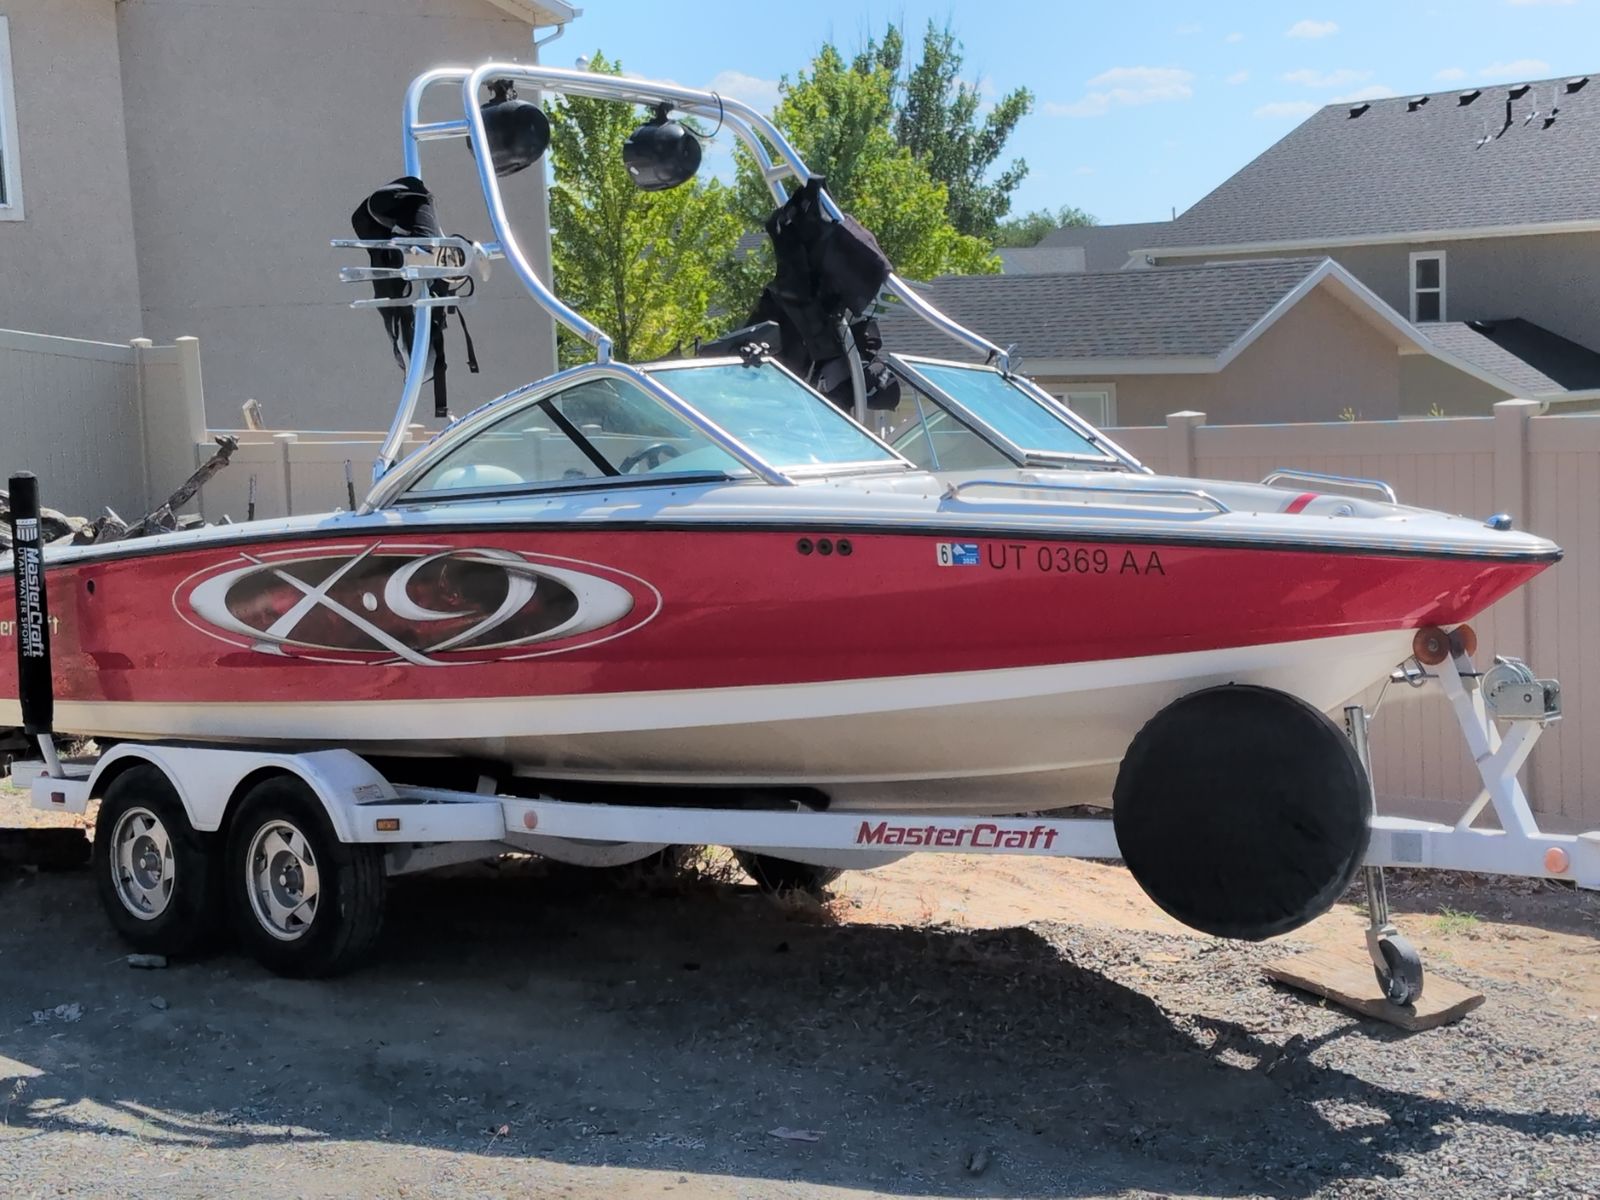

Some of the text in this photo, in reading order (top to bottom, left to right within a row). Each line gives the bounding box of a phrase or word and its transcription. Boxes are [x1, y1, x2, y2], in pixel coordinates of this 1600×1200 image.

[940, 544, 949, 564] 6
[988, 544, 1166, 576] UT 0369 AA
[19, 580, 27, 613] WATER
[26, 547, 45, 658] MasterCraft
[21, 616, 30, 658] SPORTS
[856, 821, 1059, 849] MasterCraft
